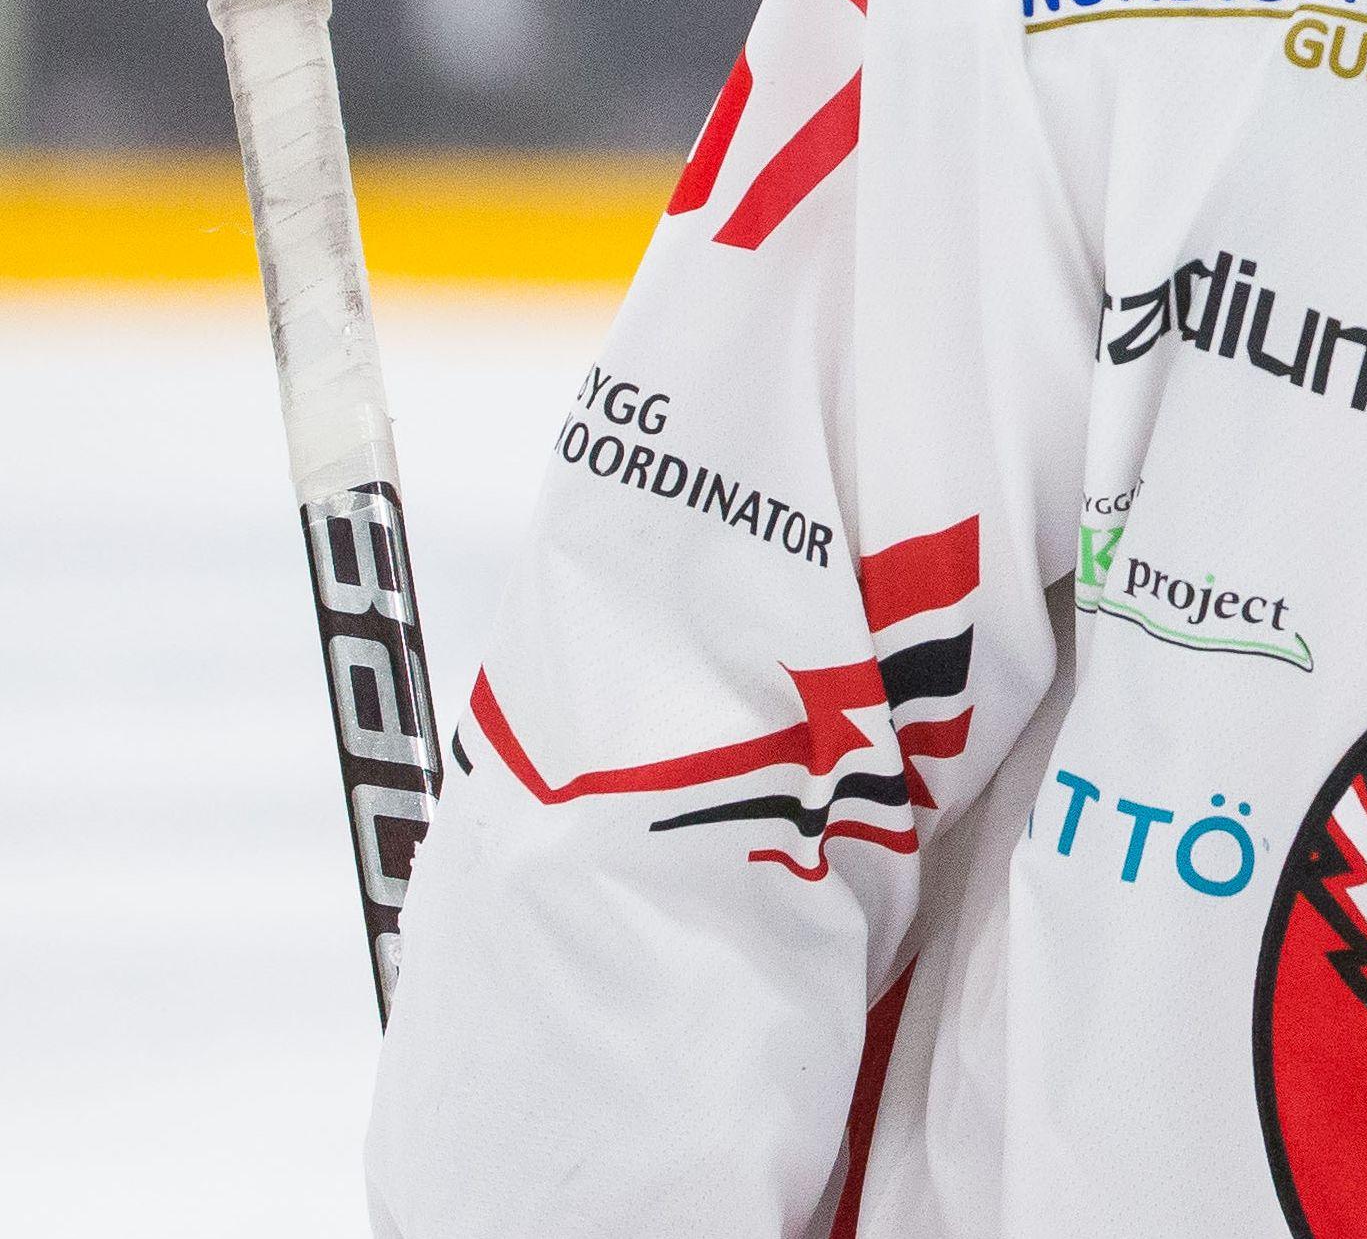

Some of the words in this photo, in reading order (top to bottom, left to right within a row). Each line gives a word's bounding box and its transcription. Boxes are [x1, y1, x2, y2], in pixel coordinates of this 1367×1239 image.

[577, 362, 671, 435] YGG
[554, 412, 833, 568] OORDINATOR
[1123, 558, 1290, 632] project
[303, 494, 440, 1030] BAU
